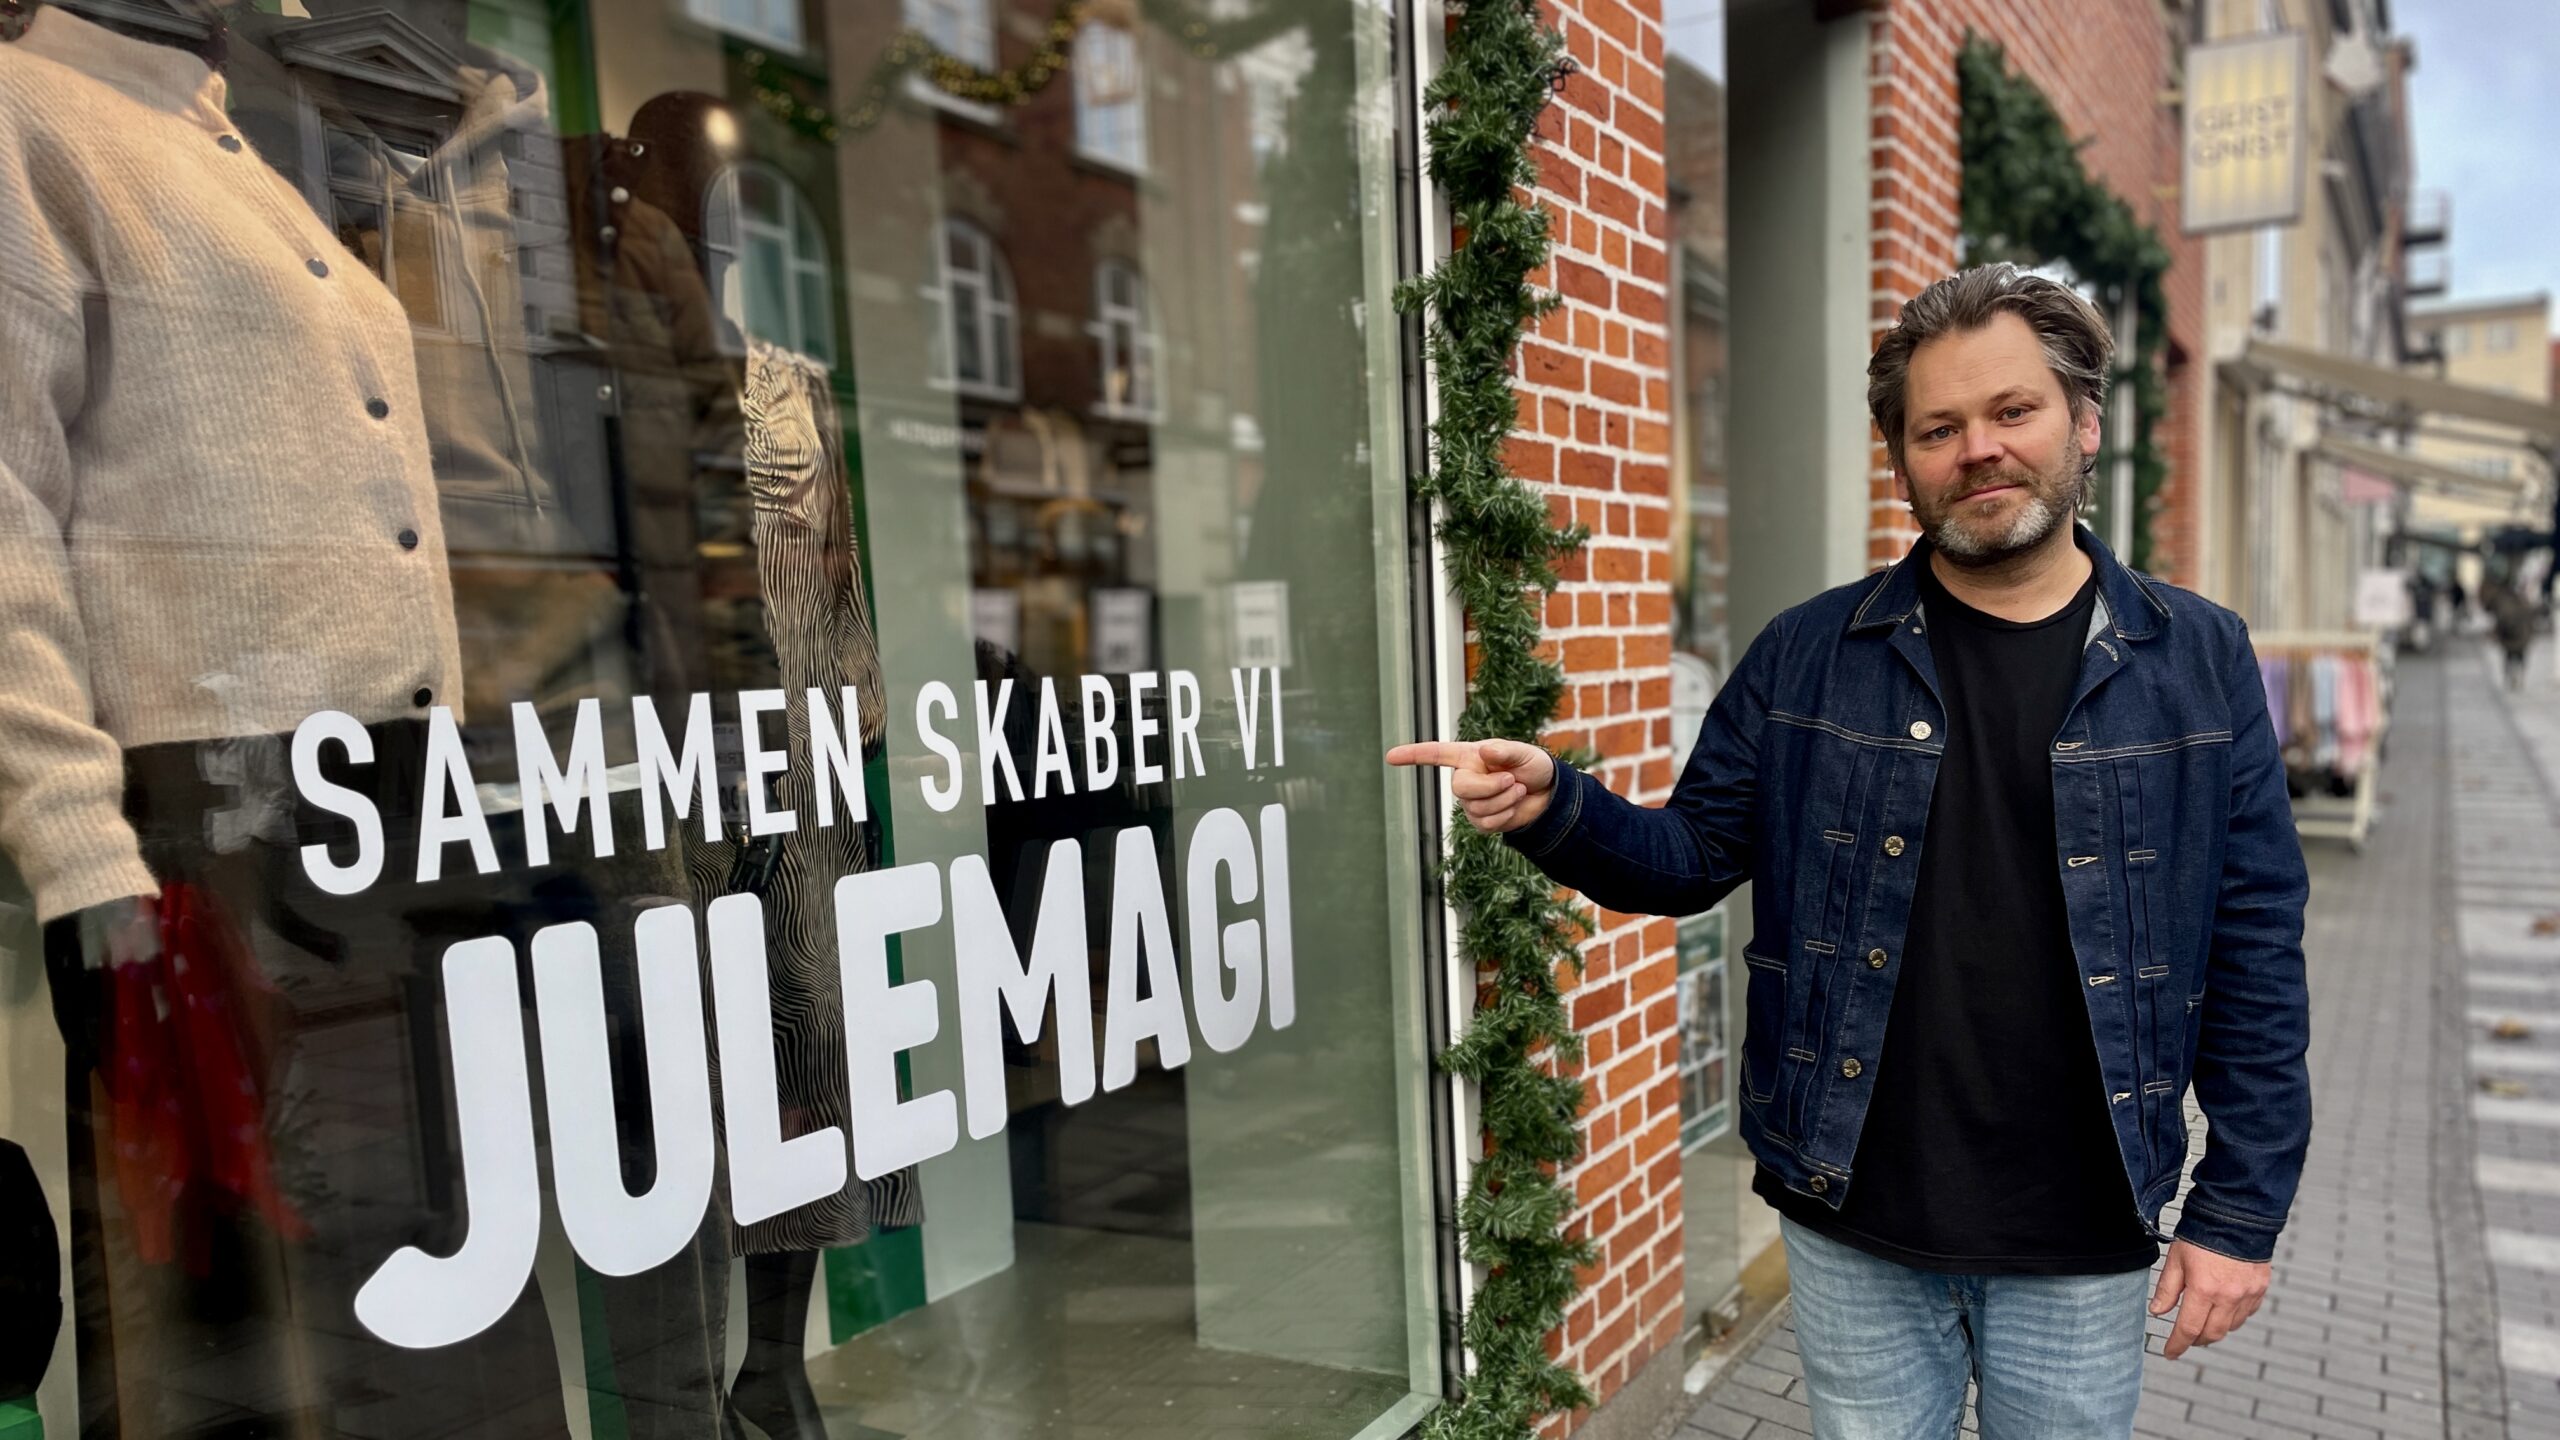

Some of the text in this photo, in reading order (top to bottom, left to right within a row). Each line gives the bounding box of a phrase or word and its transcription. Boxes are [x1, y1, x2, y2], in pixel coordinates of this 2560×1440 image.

[291, 665, 1285, 895] SAMMEN SKABER VI
[354, 803, 1297, 1348] JULEMAGI
